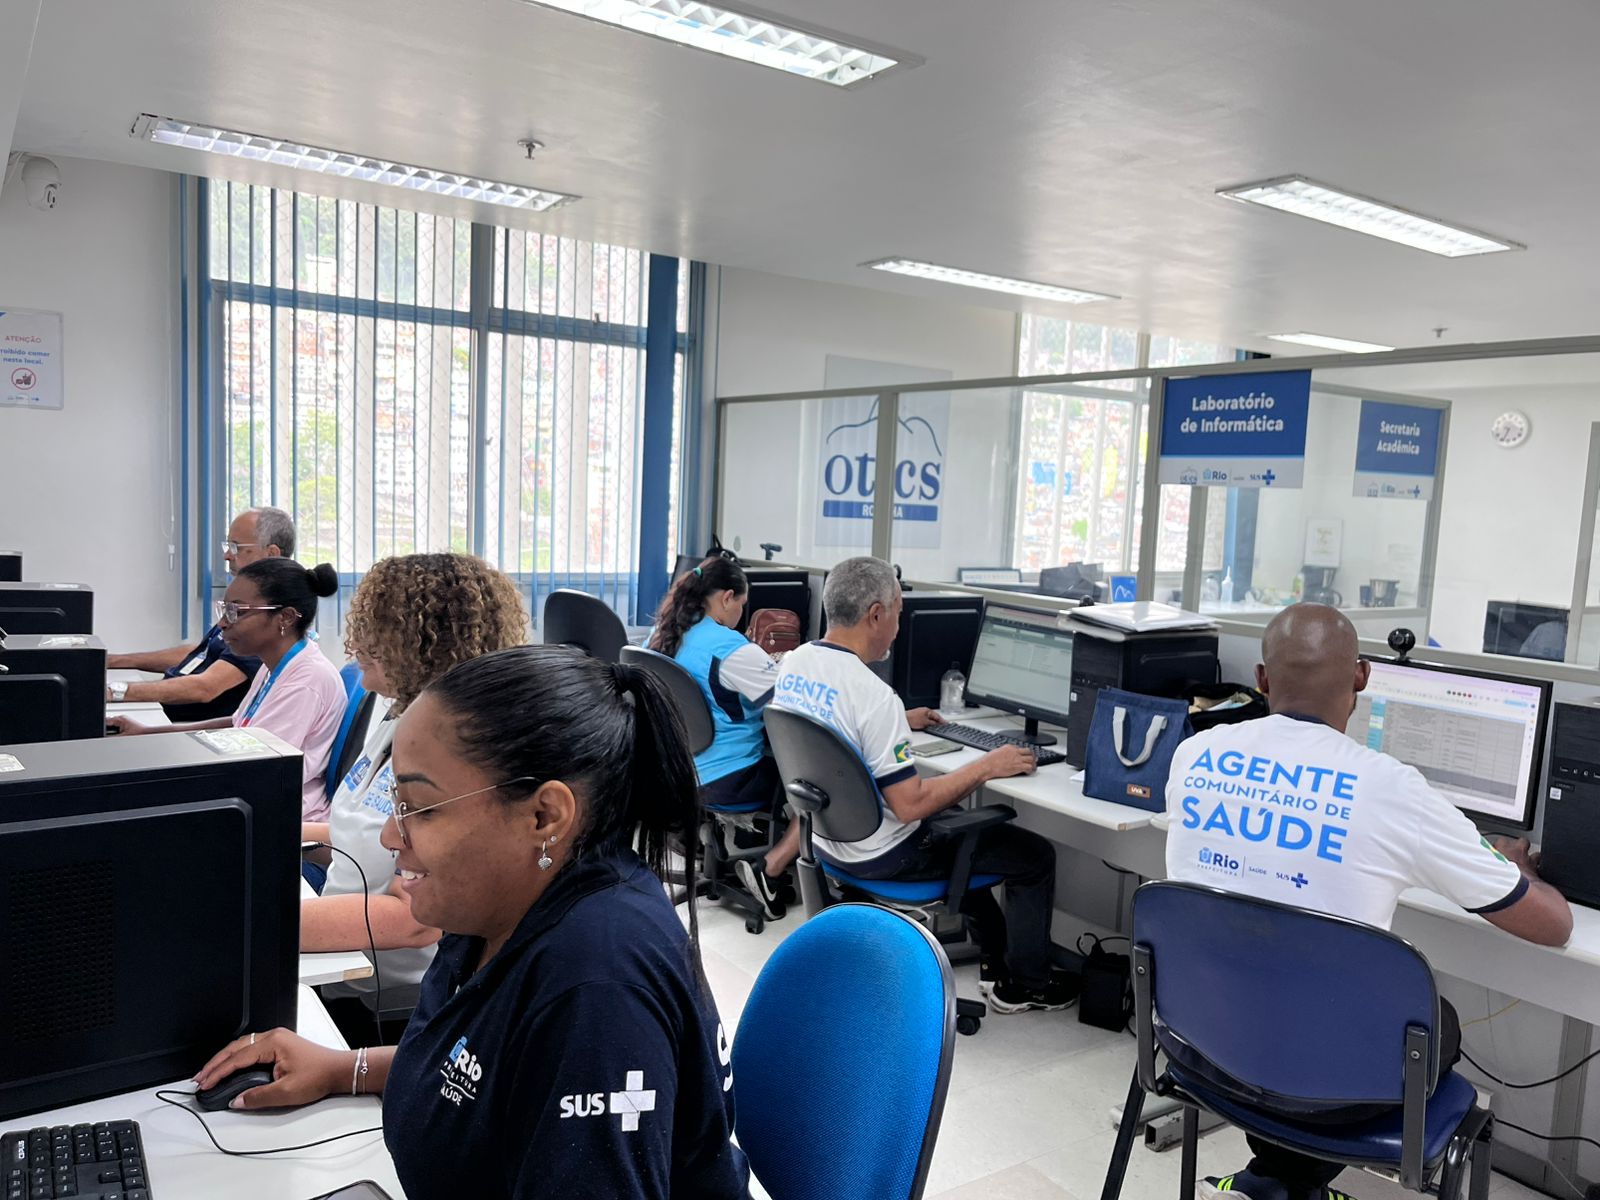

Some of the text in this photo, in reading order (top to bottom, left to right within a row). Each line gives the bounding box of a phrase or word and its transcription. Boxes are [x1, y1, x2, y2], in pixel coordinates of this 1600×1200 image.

[5, 335, 42, 344] ATENÇÃO
[1192, 392, 1275, 411] Laboratório
[1180, 415, 1284, 433] de Informática
[1380, 420, 1421, 437] Secretaria
[1376, 439, 1420, 455] Acadêmica
[824, 452, 941, 500] otcs
[1212, 470, 1228, 481] Rio
[820, 707, 833, 720] DE
[1189, 747, 1358, 801] AGENTE
[1184, 776, 1352, 820] COMUNITÁRIO DE
[1182, 795, 1348, 864] SAÚDE
[1197, 864, 1238, 877] PREFEITURA
[1213, 853, 1239, 870] Rio
[1276, 872, 1290, 881] SUS
[454, 1048, 482, 1083] Rio
[440, 1085, 463, 1106] AÚDE
[559, 1092, 605, 1118] SUS
